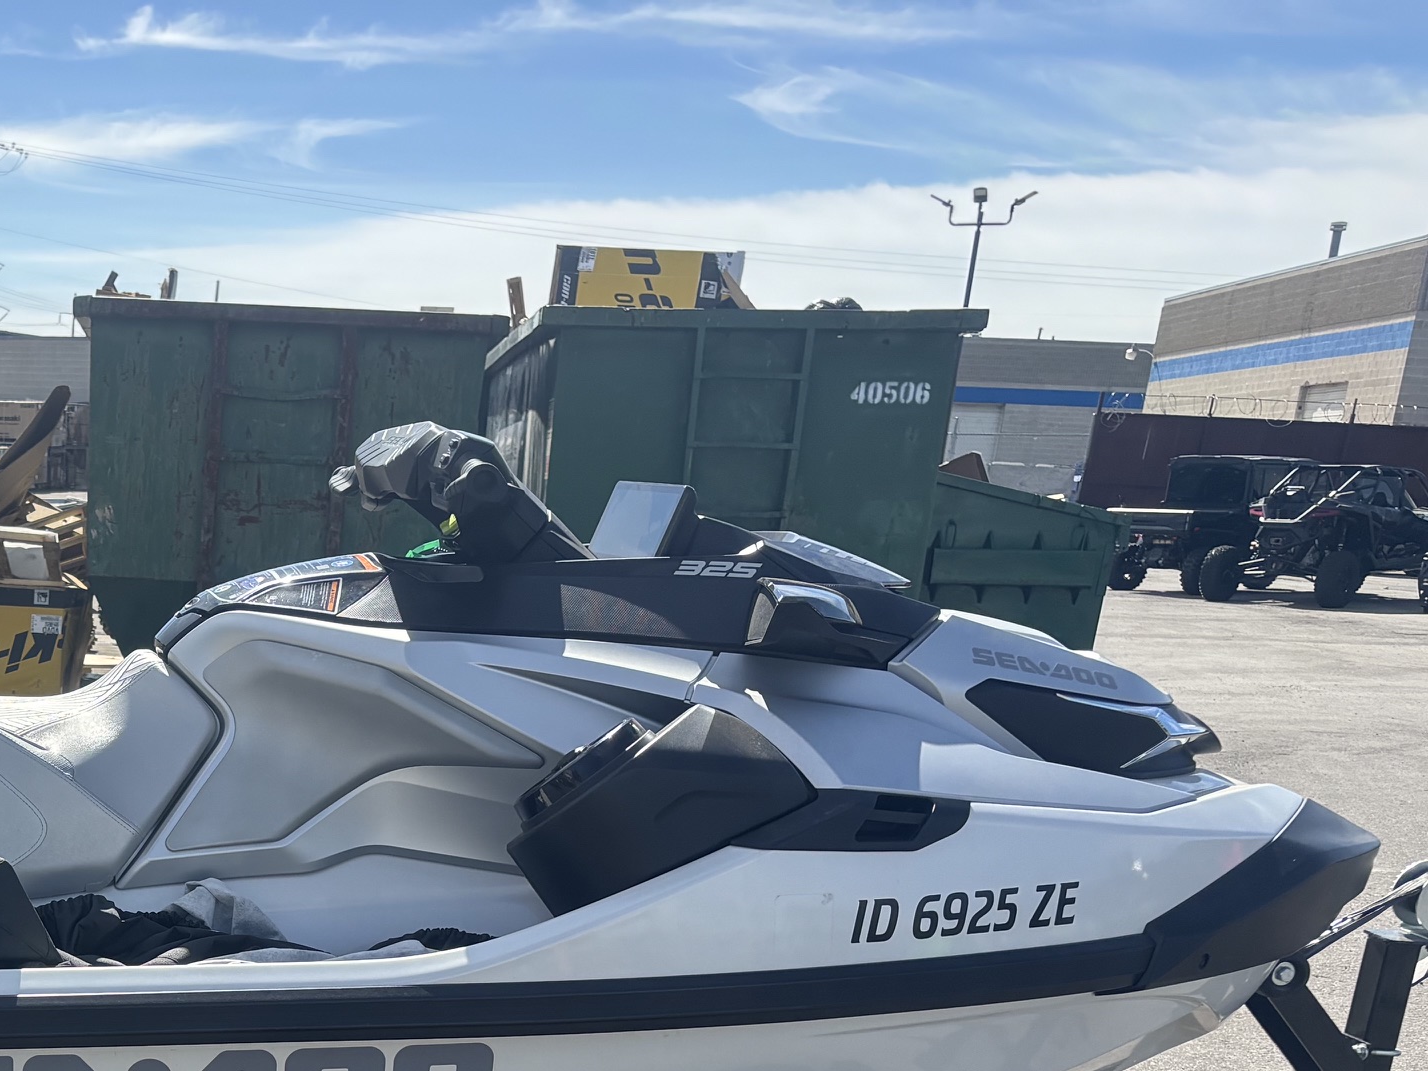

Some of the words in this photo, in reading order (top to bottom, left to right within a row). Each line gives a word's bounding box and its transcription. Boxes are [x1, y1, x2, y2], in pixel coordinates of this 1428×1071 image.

[850, 381, 931, 404] 40506
[674, 560, 763, 578] 325
[850, 898, 900, 944] ID
[912, 887, 1019, 940] 6925
[1028, 882, 1080, 928] ZE
